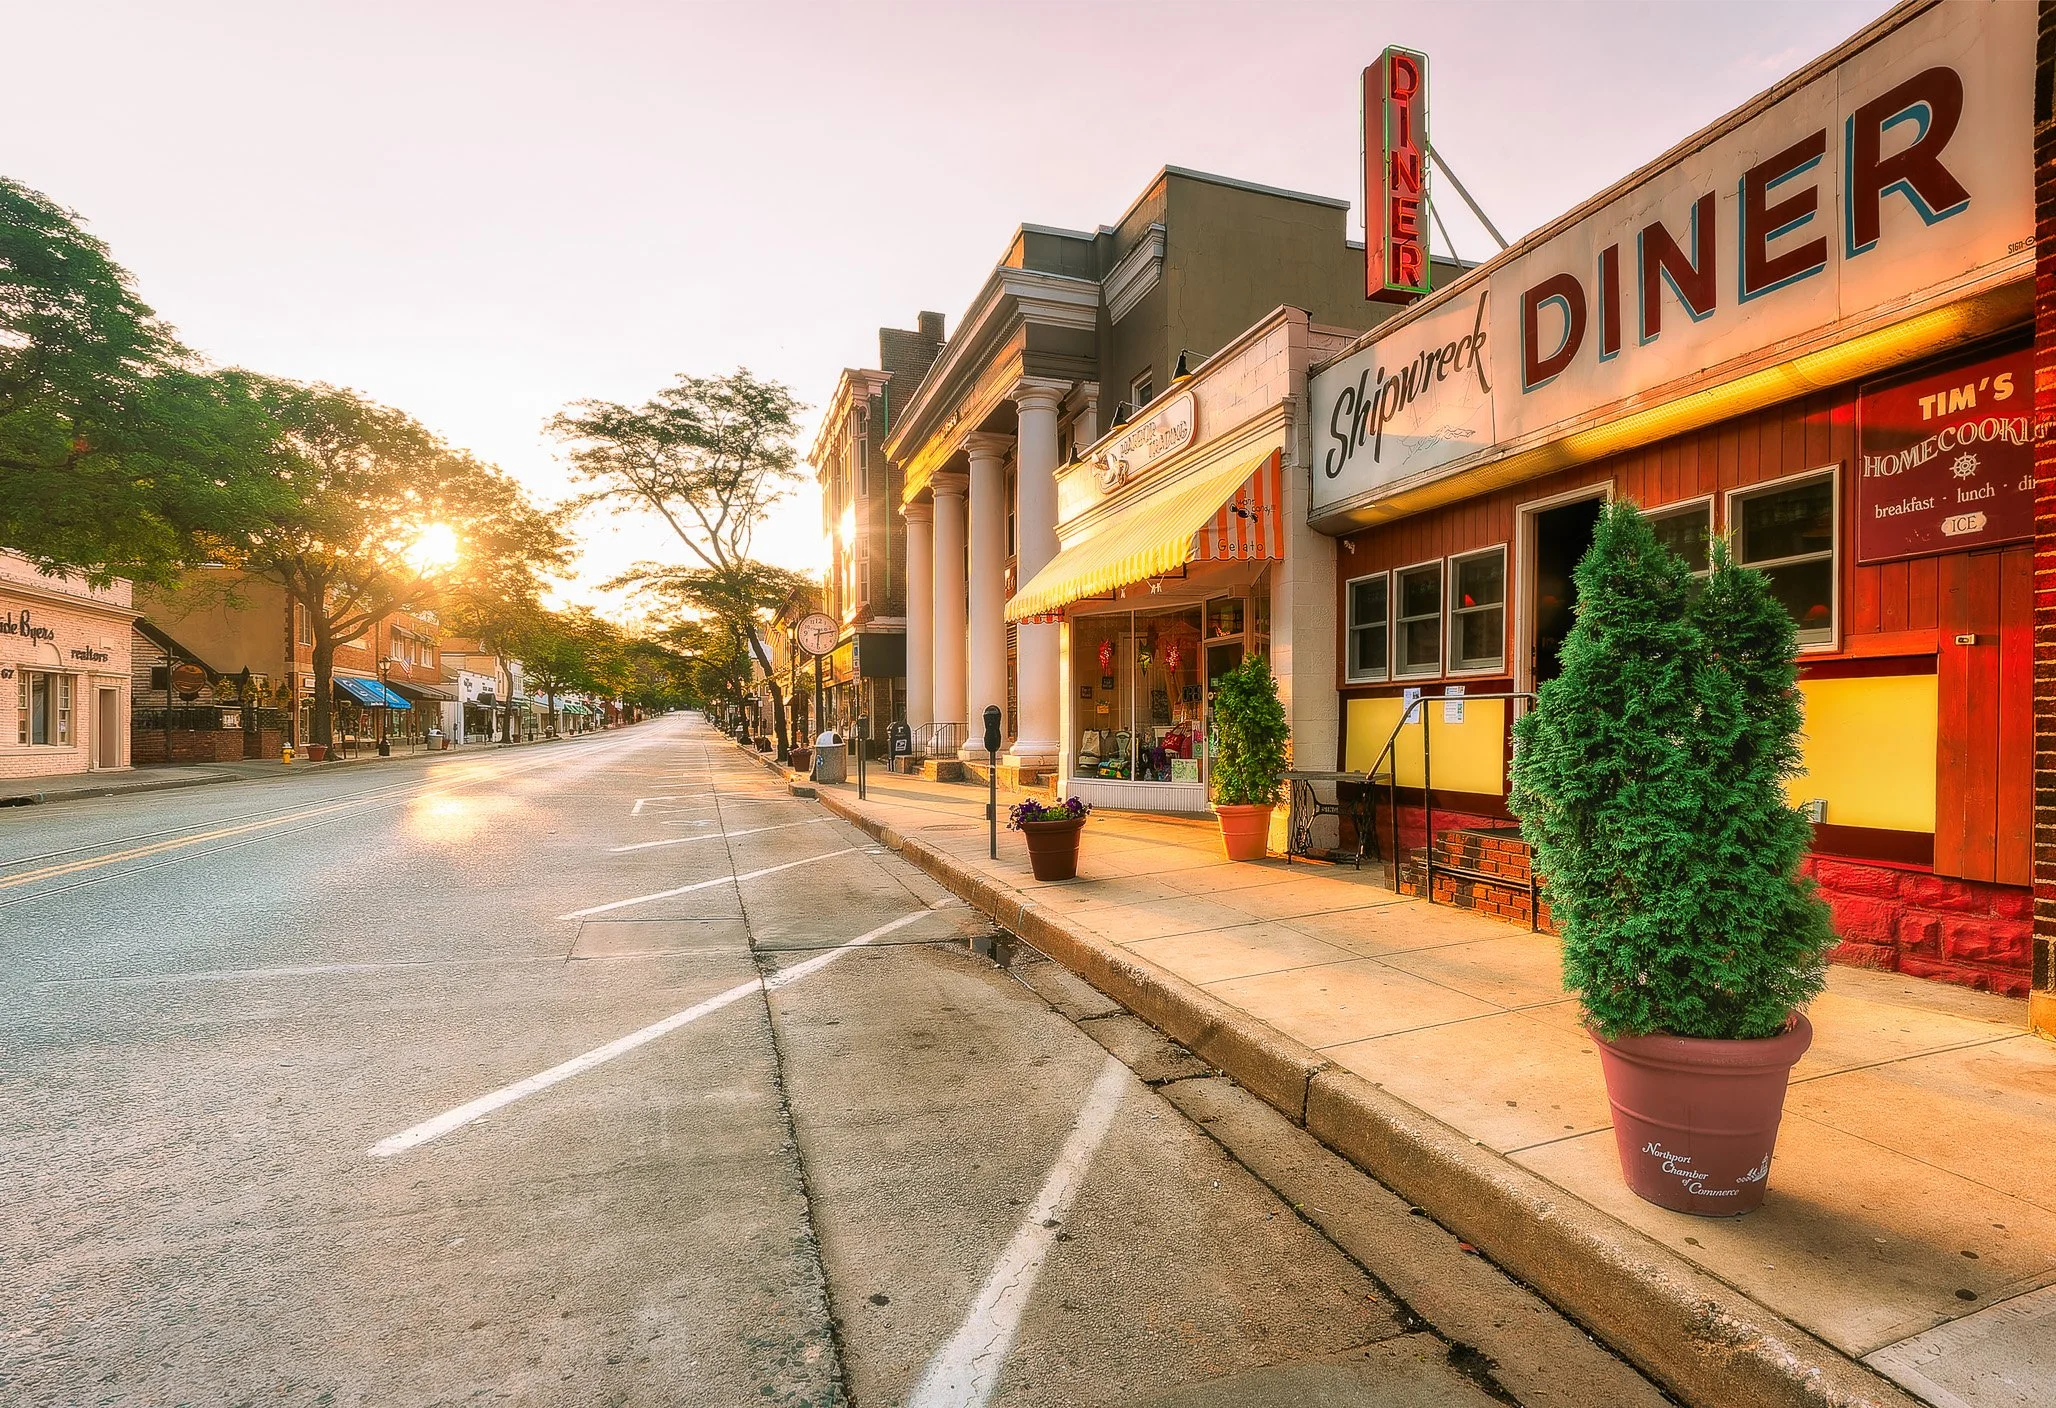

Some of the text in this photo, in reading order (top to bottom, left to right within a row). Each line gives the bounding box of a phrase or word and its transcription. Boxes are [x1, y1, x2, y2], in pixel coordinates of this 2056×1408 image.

[1390, 55, 1421, 288] DINER
[1326, 66, 1972, 479] Shipwreck DINER
[1919, 373, 2014, 420] TIM'S
[1875, 497, 1935, 519] breakfast
[1957, 482, 1996, 503] lunch
[1952, 516, 1978, 533] ICE
[1217, 538, 1264, 556] Gelato
[20, 609, 55, 647] Byers
[71, 645, 109, 662] realtors
[1, 668, 15, 679] 67
[1642, 1142, 1692, 1164] Northport
[1661, 1160, 1709, 1180] Chamber
[1682, 1178, 1692, 1187] of
[1688, 1182, 1740, 1197] Commerce
